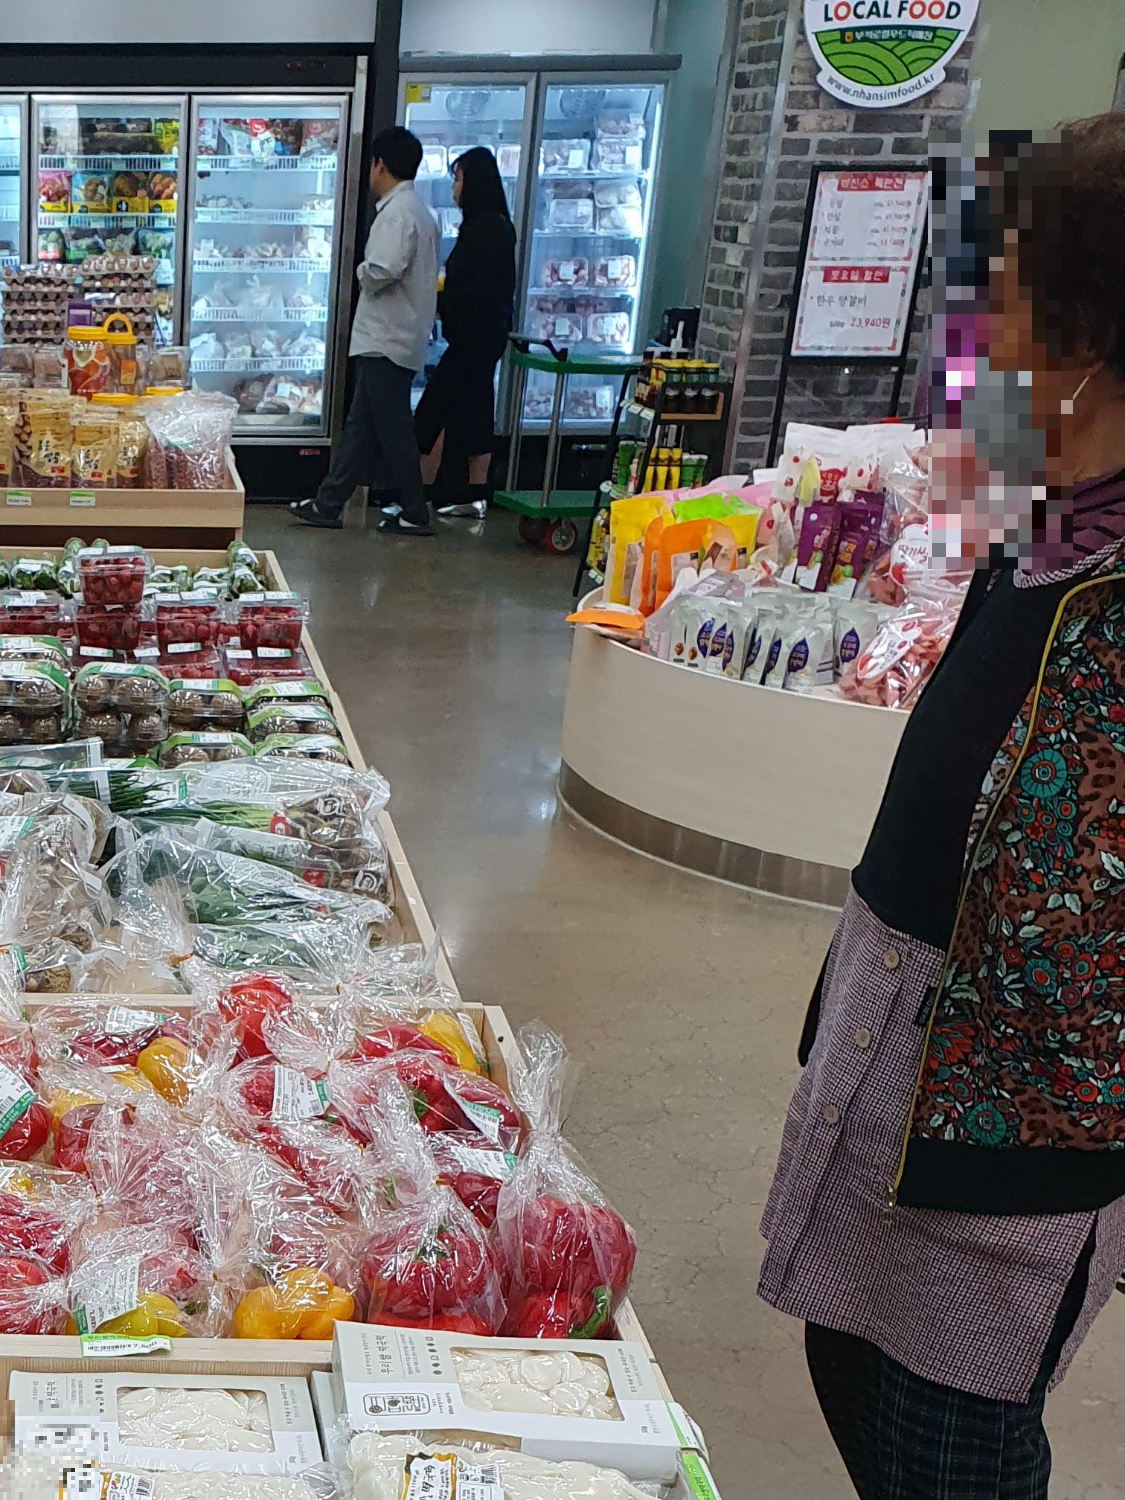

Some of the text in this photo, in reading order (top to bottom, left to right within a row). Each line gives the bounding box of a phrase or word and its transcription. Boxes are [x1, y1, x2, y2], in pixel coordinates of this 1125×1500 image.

[824, 0, 961, 22] LOCAL FOOD
[827, 73, 935, 101] www.nhansimfood.kr
